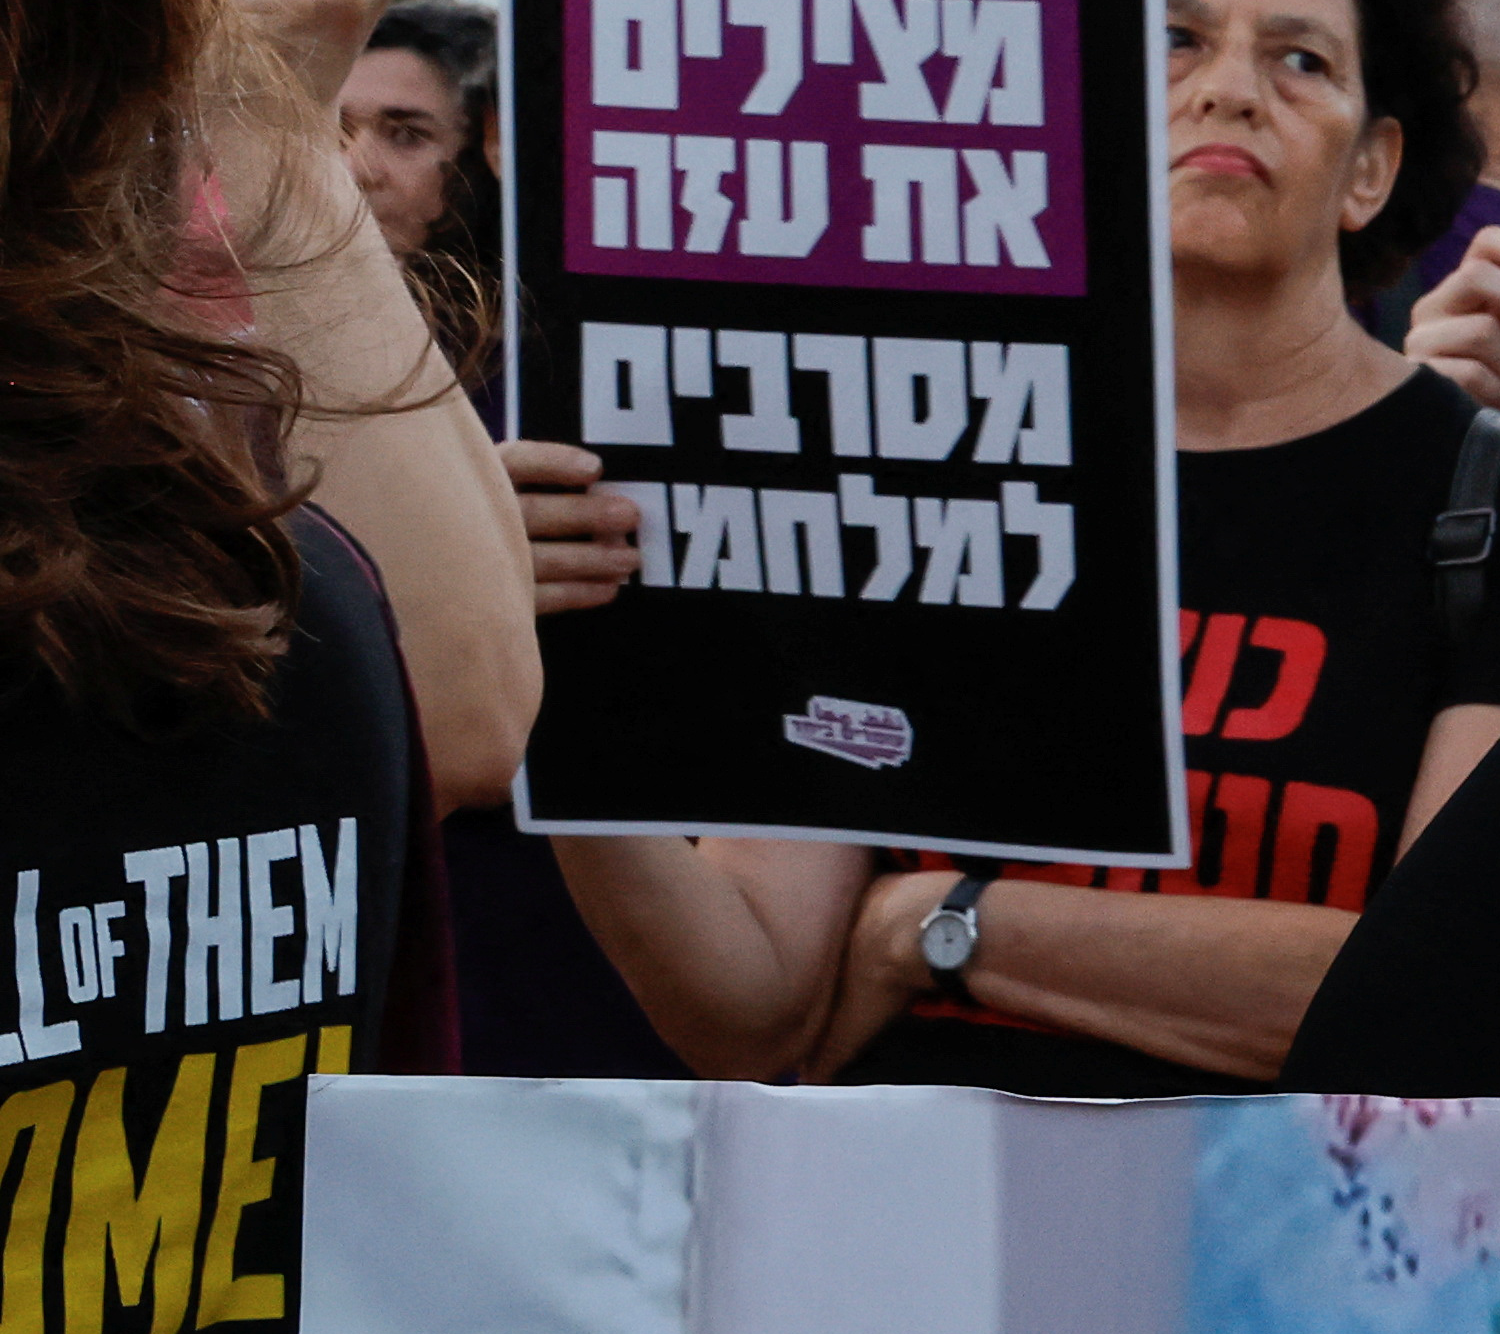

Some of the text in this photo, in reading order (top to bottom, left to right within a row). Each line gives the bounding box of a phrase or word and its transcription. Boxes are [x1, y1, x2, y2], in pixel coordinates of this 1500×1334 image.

[591, 129, 1051, 269] את עזה
[580, 322, 1072, 467] מסרבים
[59, 900, 126, 1004] OF
[123, 817, 358, 1034] THEM
